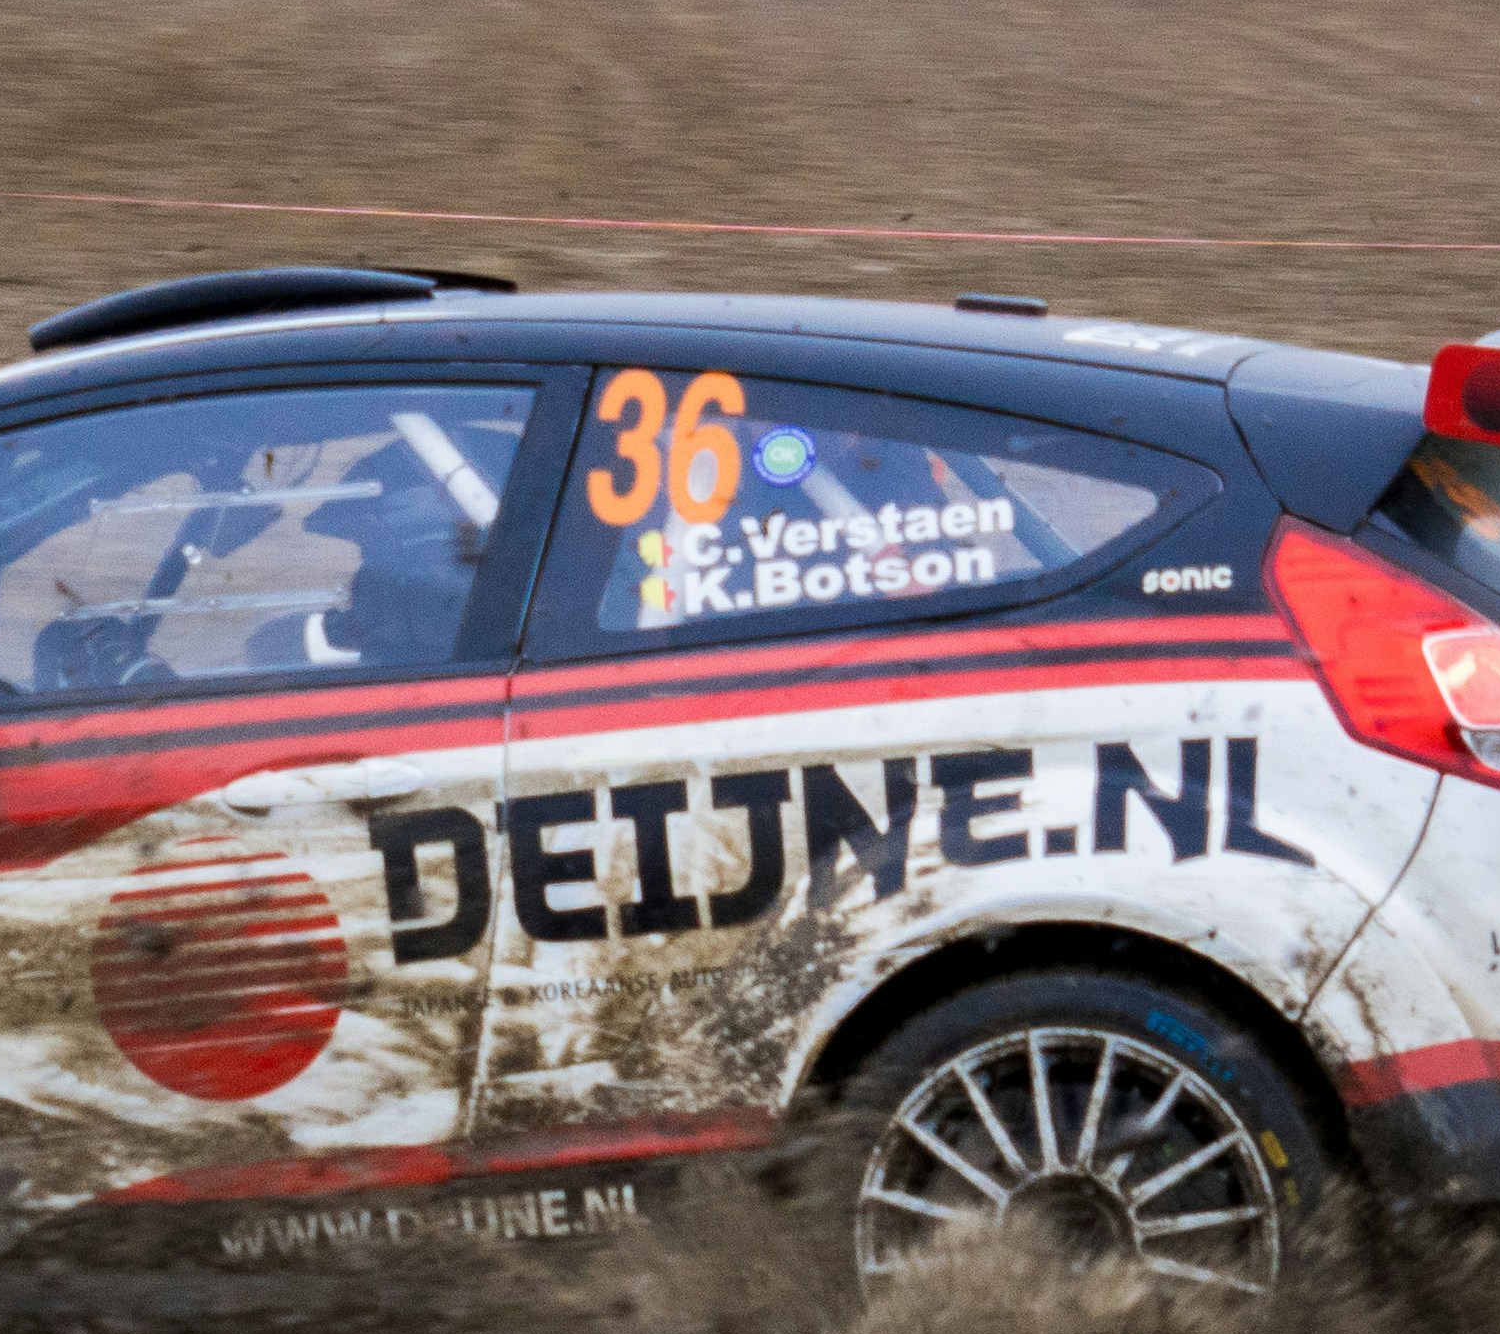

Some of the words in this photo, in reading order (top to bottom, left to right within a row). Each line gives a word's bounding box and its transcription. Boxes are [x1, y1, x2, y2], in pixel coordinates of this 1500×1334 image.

[586, 368, 746, 527] 36
[683, 498, 1015, 567] C.Verstaen
[683, 547, 996, 626] K.Botson
[366, 736, 1317, 965] DEIJNE.NL
